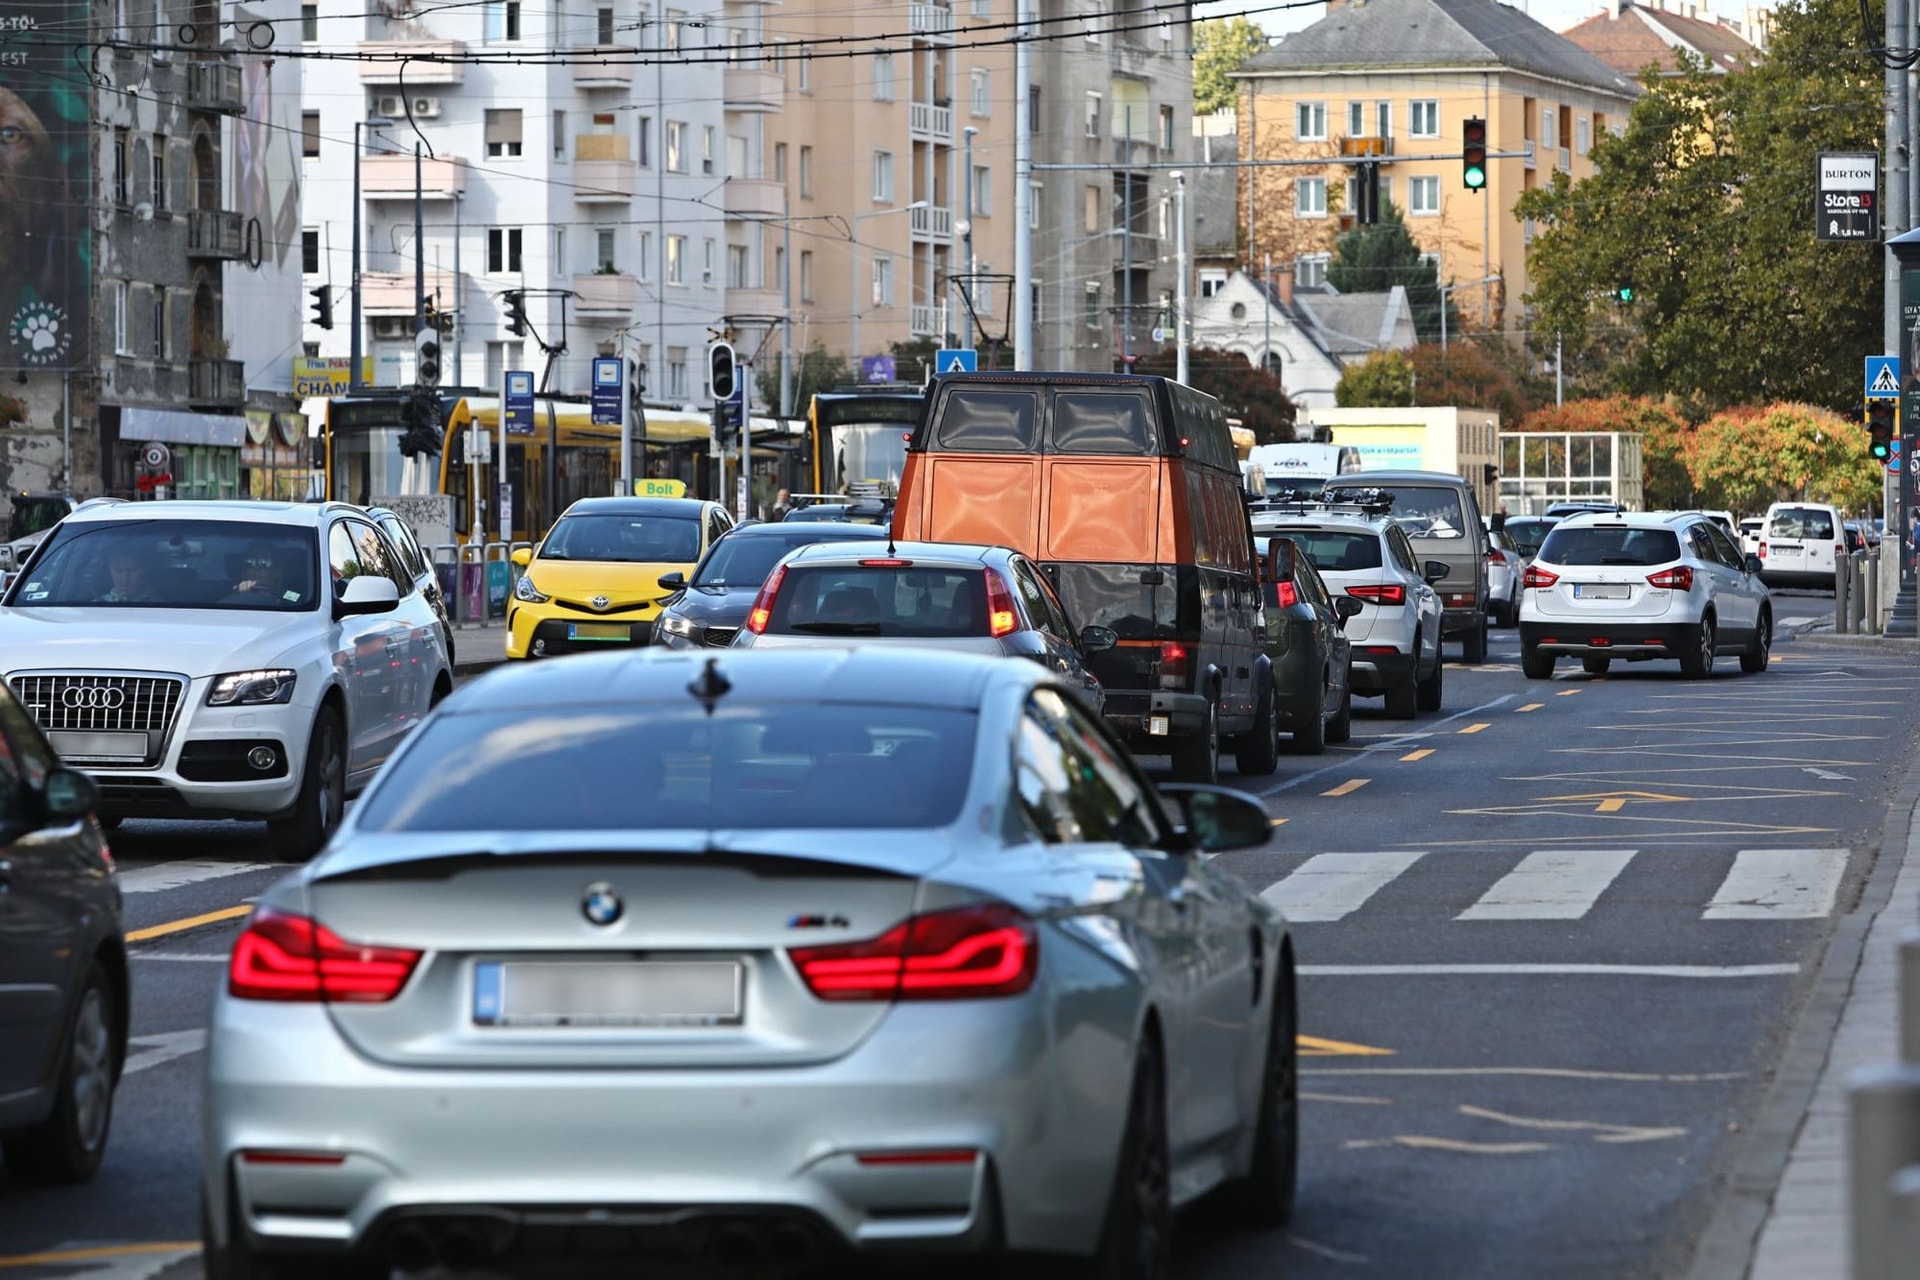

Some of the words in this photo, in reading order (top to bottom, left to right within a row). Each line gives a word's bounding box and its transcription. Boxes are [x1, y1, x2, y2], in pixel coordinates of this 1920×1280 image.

[1825, 170, 1872, 178] BURTON
[1824, 193, 1872, 207] Store13
[1853, 229, 1865, 237] km
[297, 382, 370, 395] CHAN
[647, 482, 674, 495] Bolt
